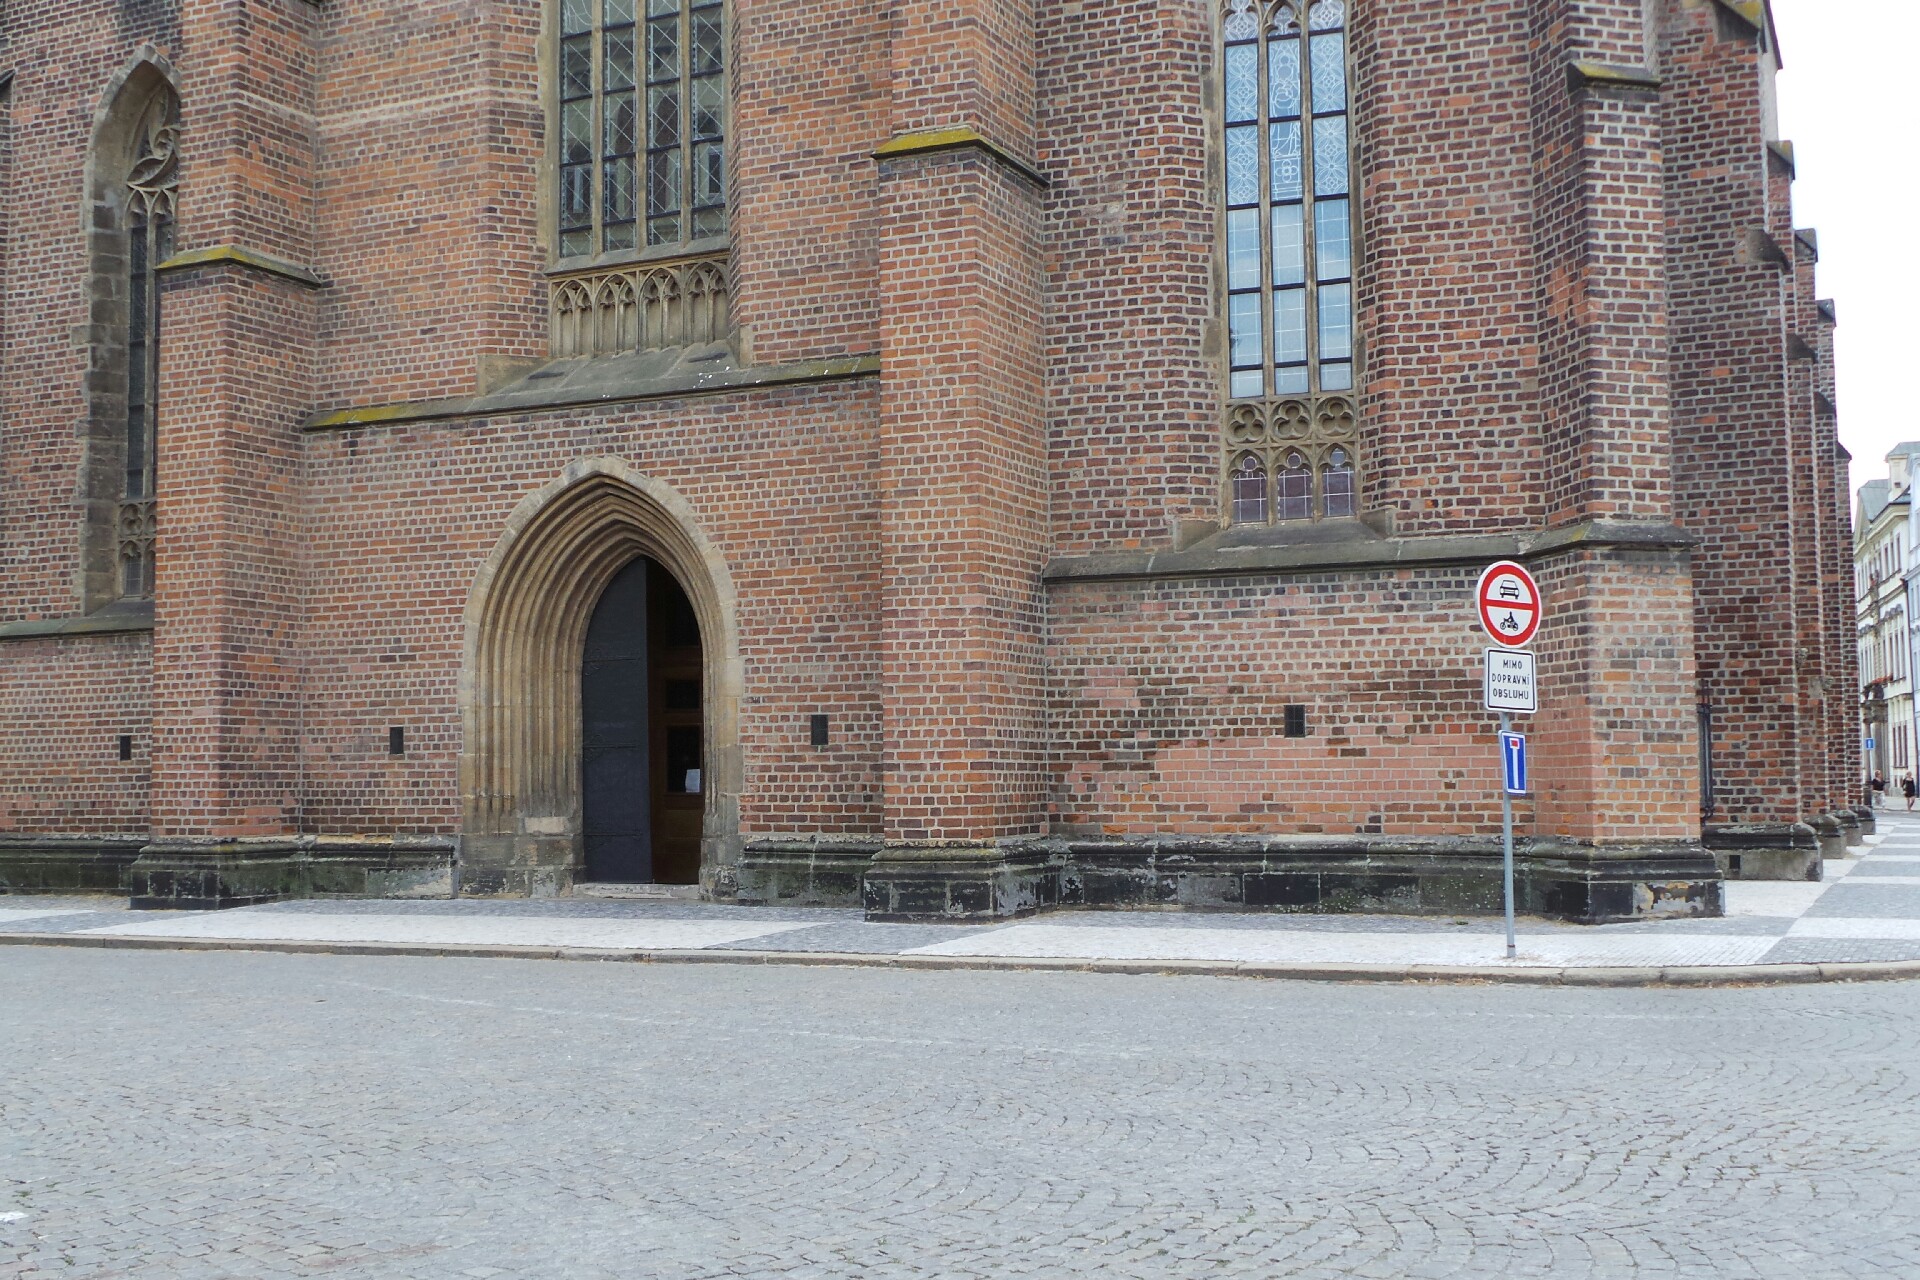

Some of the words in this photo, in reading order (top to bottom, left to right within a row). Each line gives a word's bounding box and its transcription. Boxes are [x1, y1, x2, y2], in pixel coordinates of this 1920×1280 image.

[1503, 659, 1522, 669] MIMO
[1491, 673, 1530, 685] DOPRAVNÍ
[1492, 688, 1529, 700] OBSLUHU
